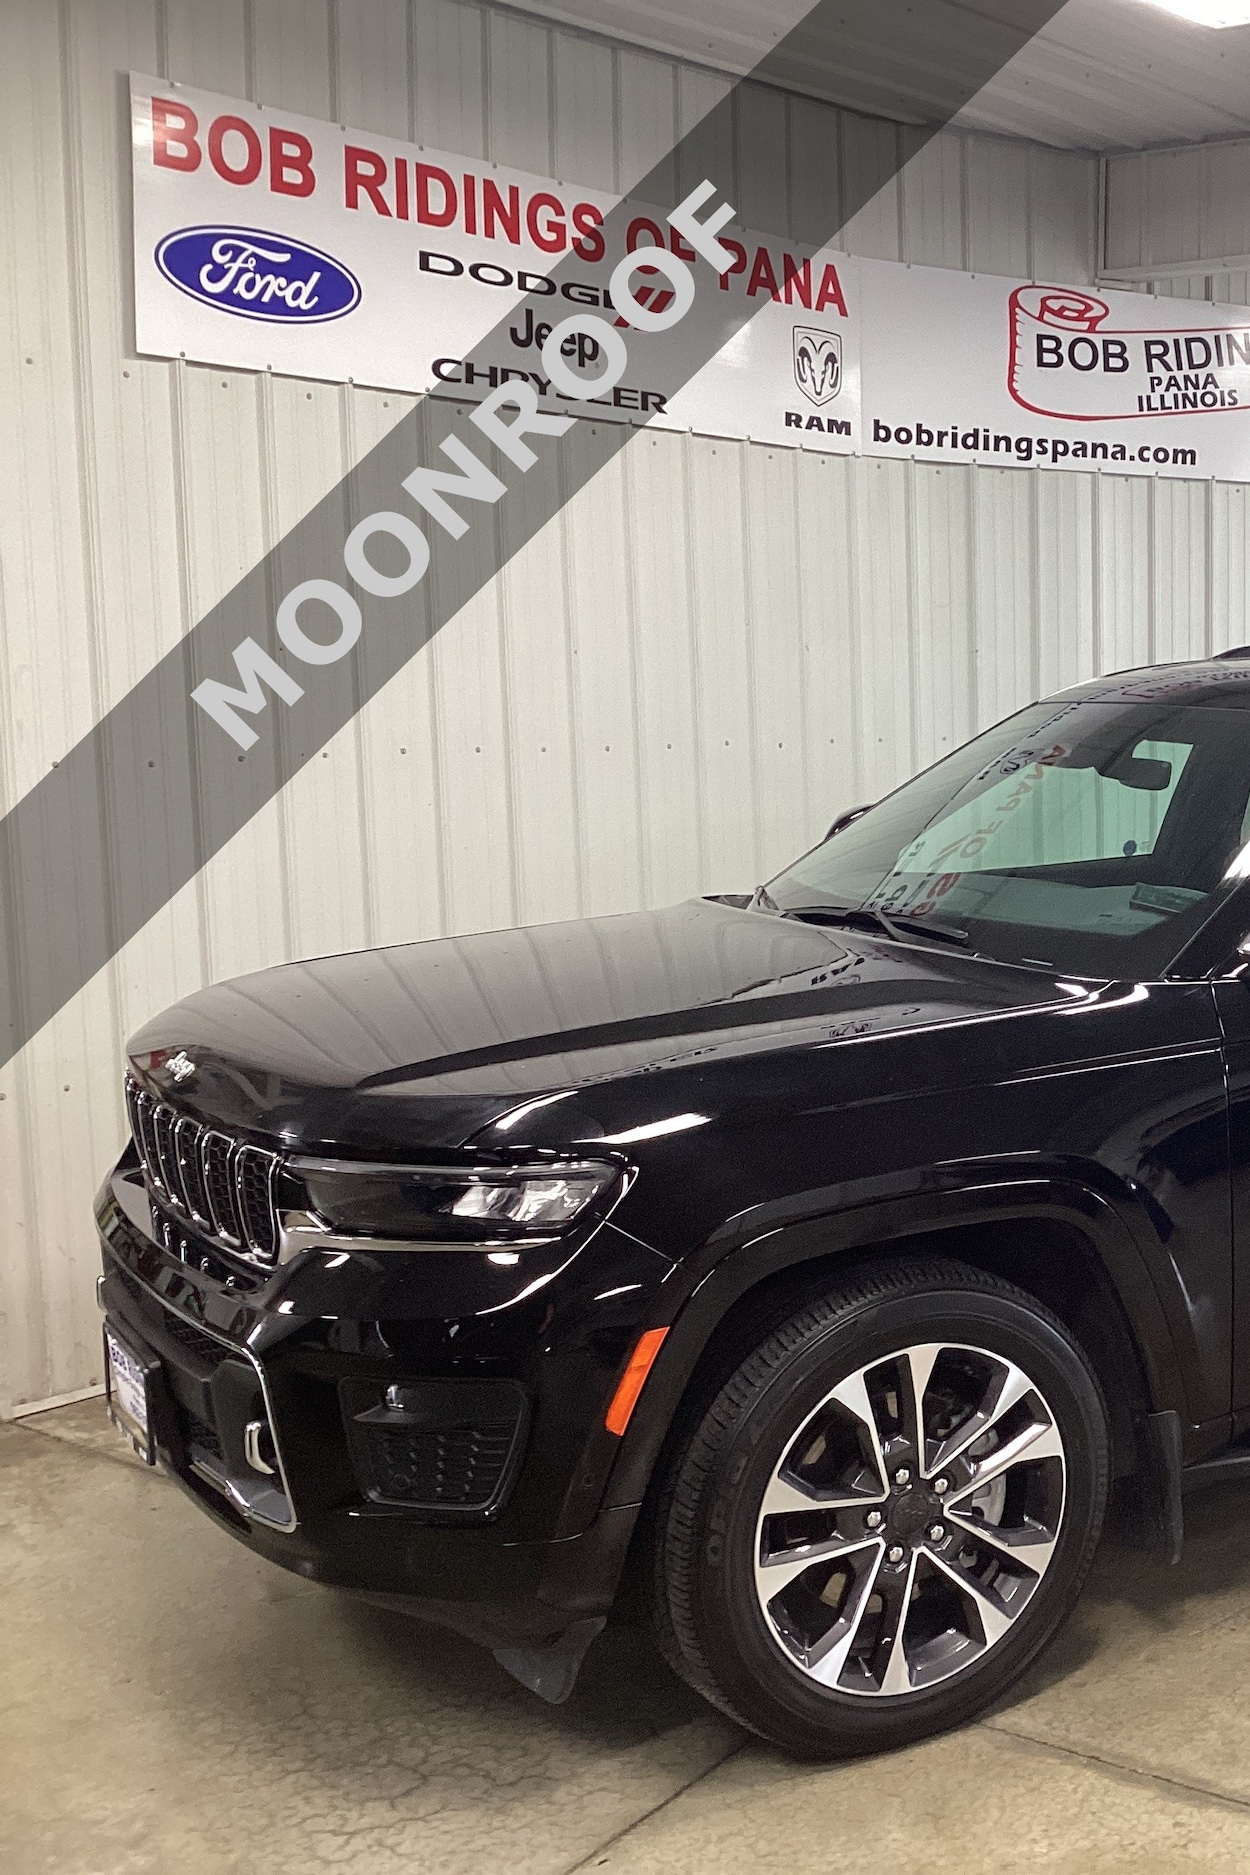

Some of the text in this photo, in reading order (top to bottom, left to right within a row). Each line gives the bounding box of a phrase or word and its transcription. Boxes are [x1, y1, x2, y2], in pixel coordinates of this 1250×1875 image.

[151, 96, 316, 198] BOB
[344, 144, 606, 263] RIDINGS
[717, 236, 849, 318] PANA
[199, 238, 322, 310] Ford
[1035, 333, 1130, 374] BOB
[1136, 389, 1239, 413] ILLINOIS
[1149, 372, 1220, 394] PANA
[784, 411, 852, 436] RAM
[872, 418, 1198, 466] bobridingspana.com
